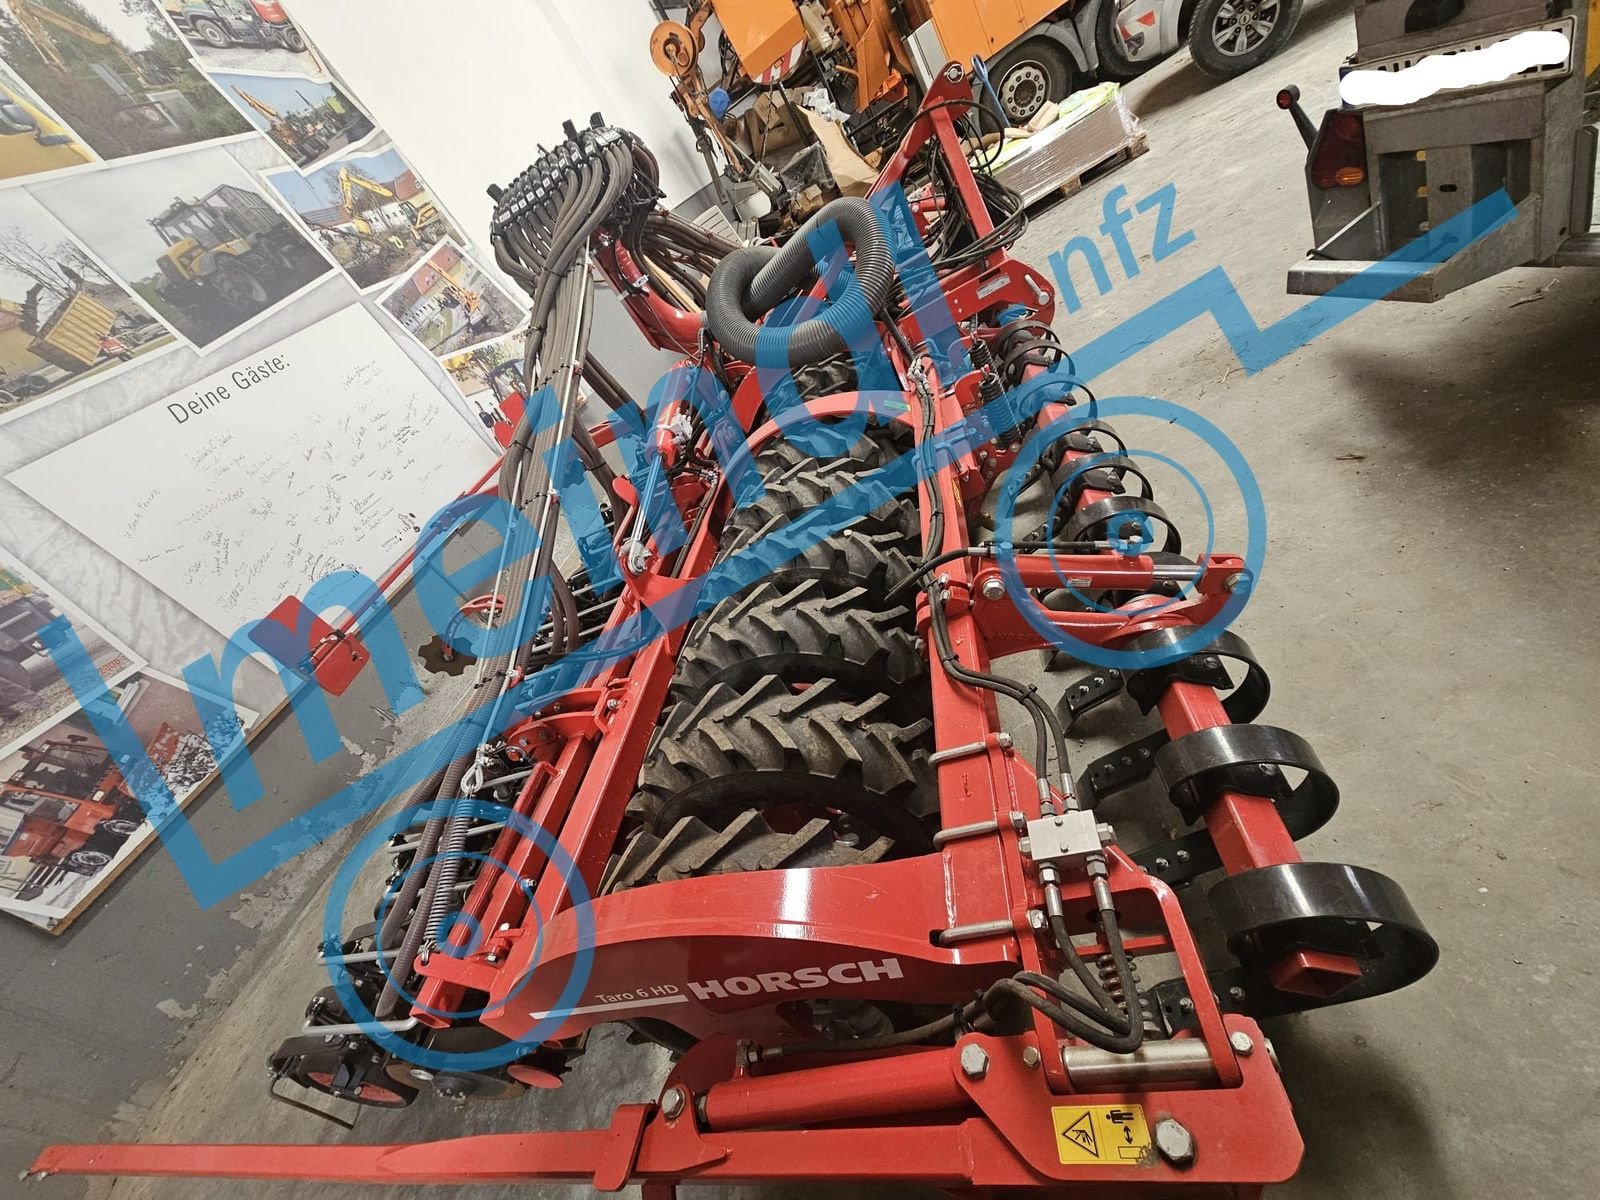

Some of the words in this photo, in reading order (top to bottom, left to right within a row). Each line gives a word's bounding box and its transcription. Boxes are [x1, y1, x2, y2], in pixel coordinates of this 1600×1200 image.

[167, 386, 231, 424] Deine
[231, 355, 291, 390] Gäste:
[595, 991, 635, 1004] Taro
[638, 988, 648, 999] 6
[650, 984, 680, 997] HD
[687, 957, 905, 1000] HORSCH
